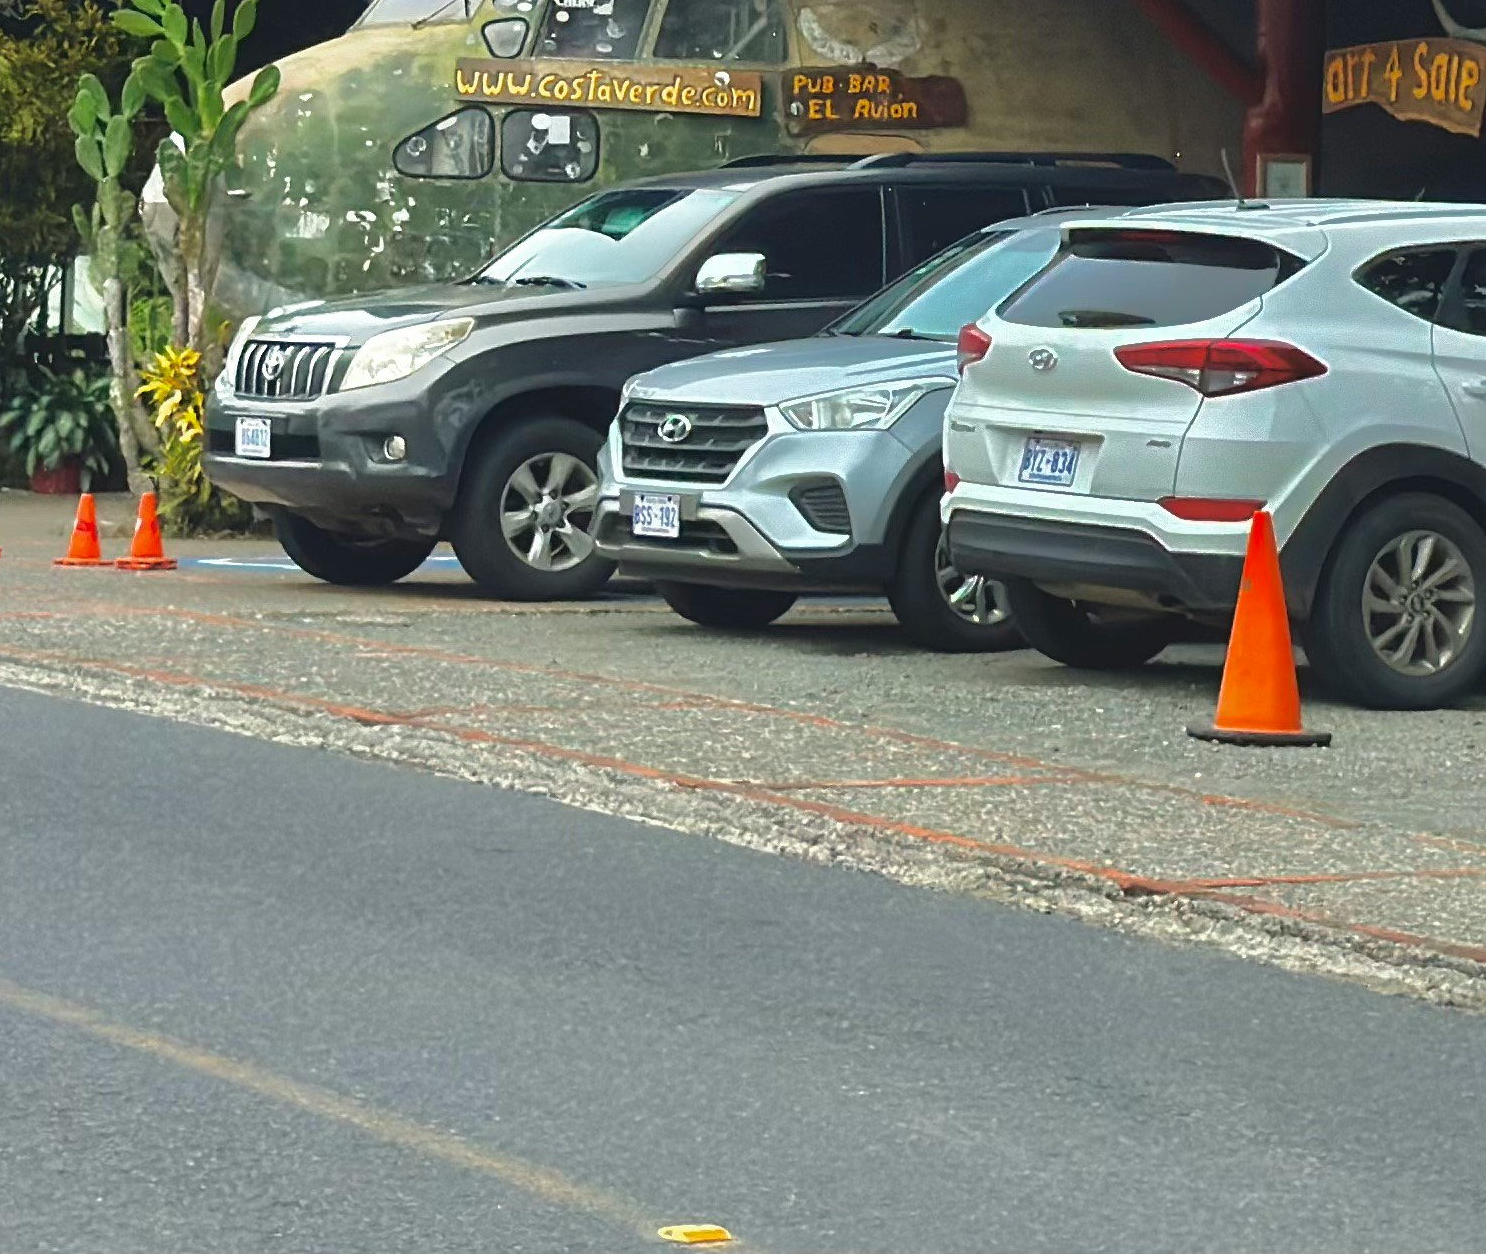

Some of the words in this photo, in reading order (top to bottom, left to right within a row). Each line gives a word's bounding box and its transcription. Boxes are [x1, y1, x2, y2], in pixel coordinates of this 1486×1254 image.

[793, 74, 834, 95] PUB
[848, 74, 890, 94] BAR
[1412, 41, 1480, 112] Sale
[635, 505, 676, 527] BSS-192
